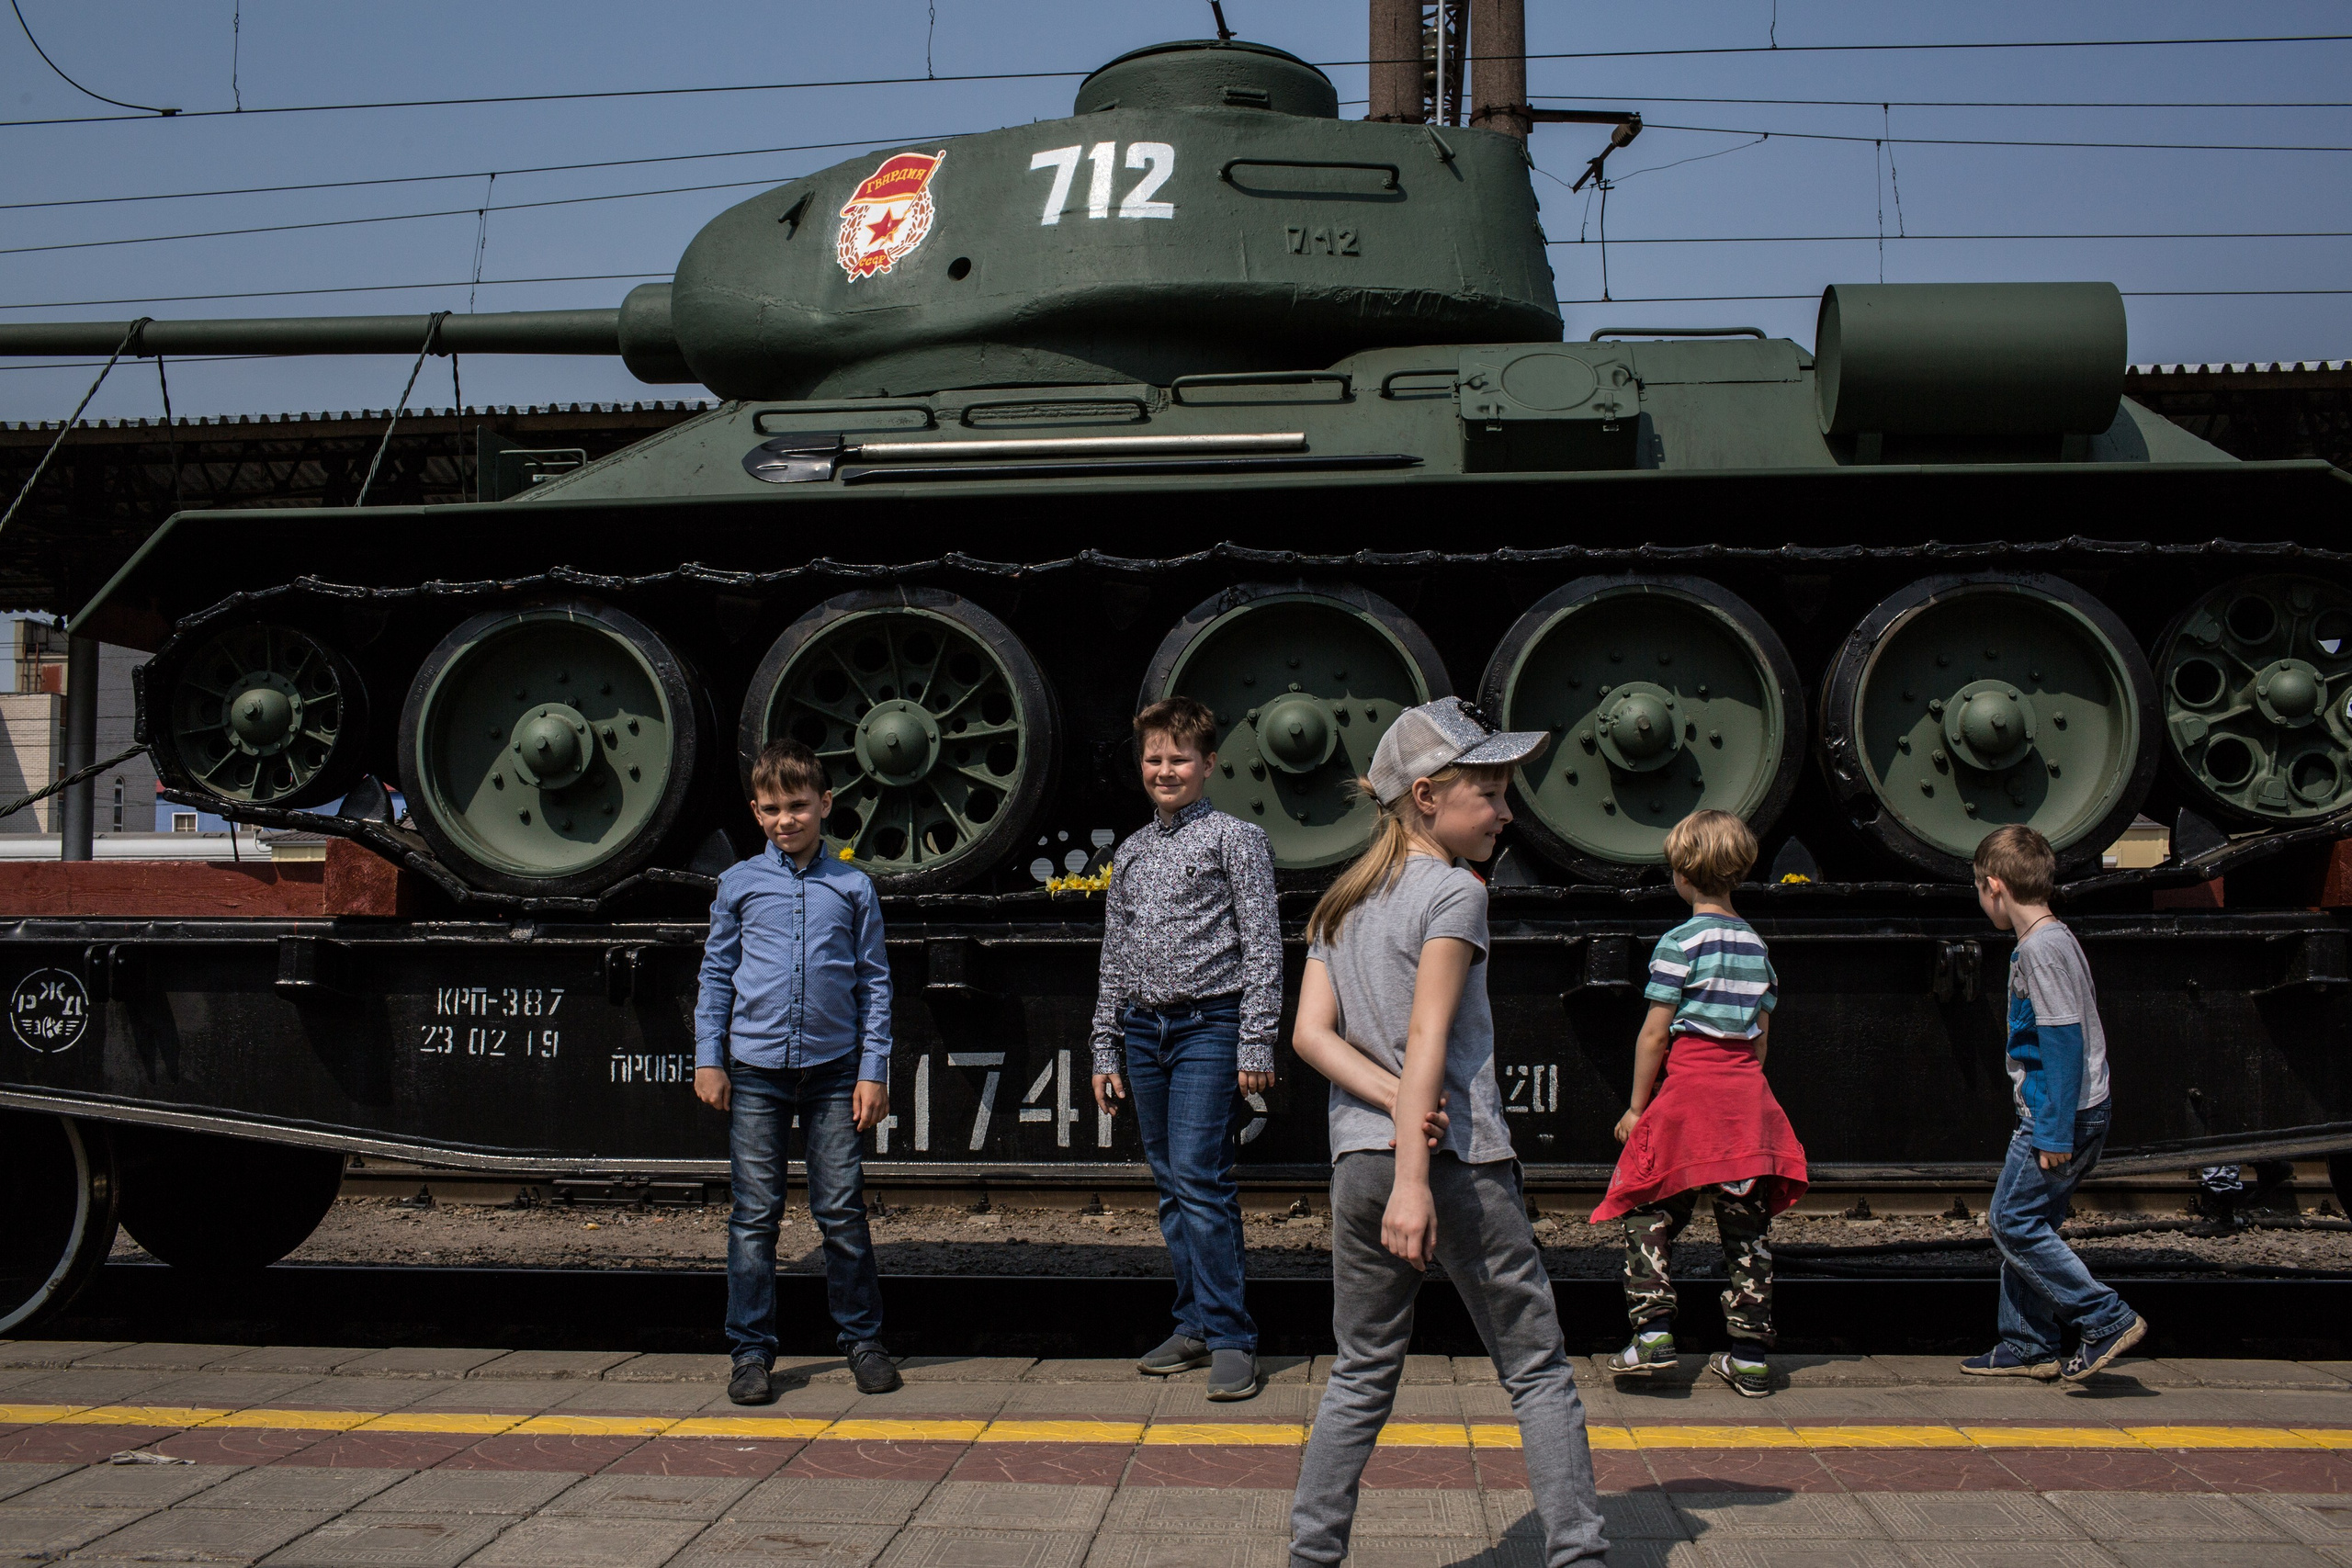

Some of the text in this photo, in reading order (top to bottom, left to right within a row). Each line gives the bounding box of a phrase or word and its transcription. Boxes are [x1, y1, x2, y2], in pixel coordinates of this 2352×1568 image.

[865, 167, 927, 194] ГВАРДИЯ
[1030, 141, 1174, 226] 712
[1287, 227, 1360, 256] 712
[859, 254, 887, 266] СССР
[17, 981, 83, 1016] РЖД
[436, 987, 565, 1016] КРП-387
[420, 1026, 559, 1057] 23 02 19
[611, 1054, 697, 1083] ПРОБЕ
